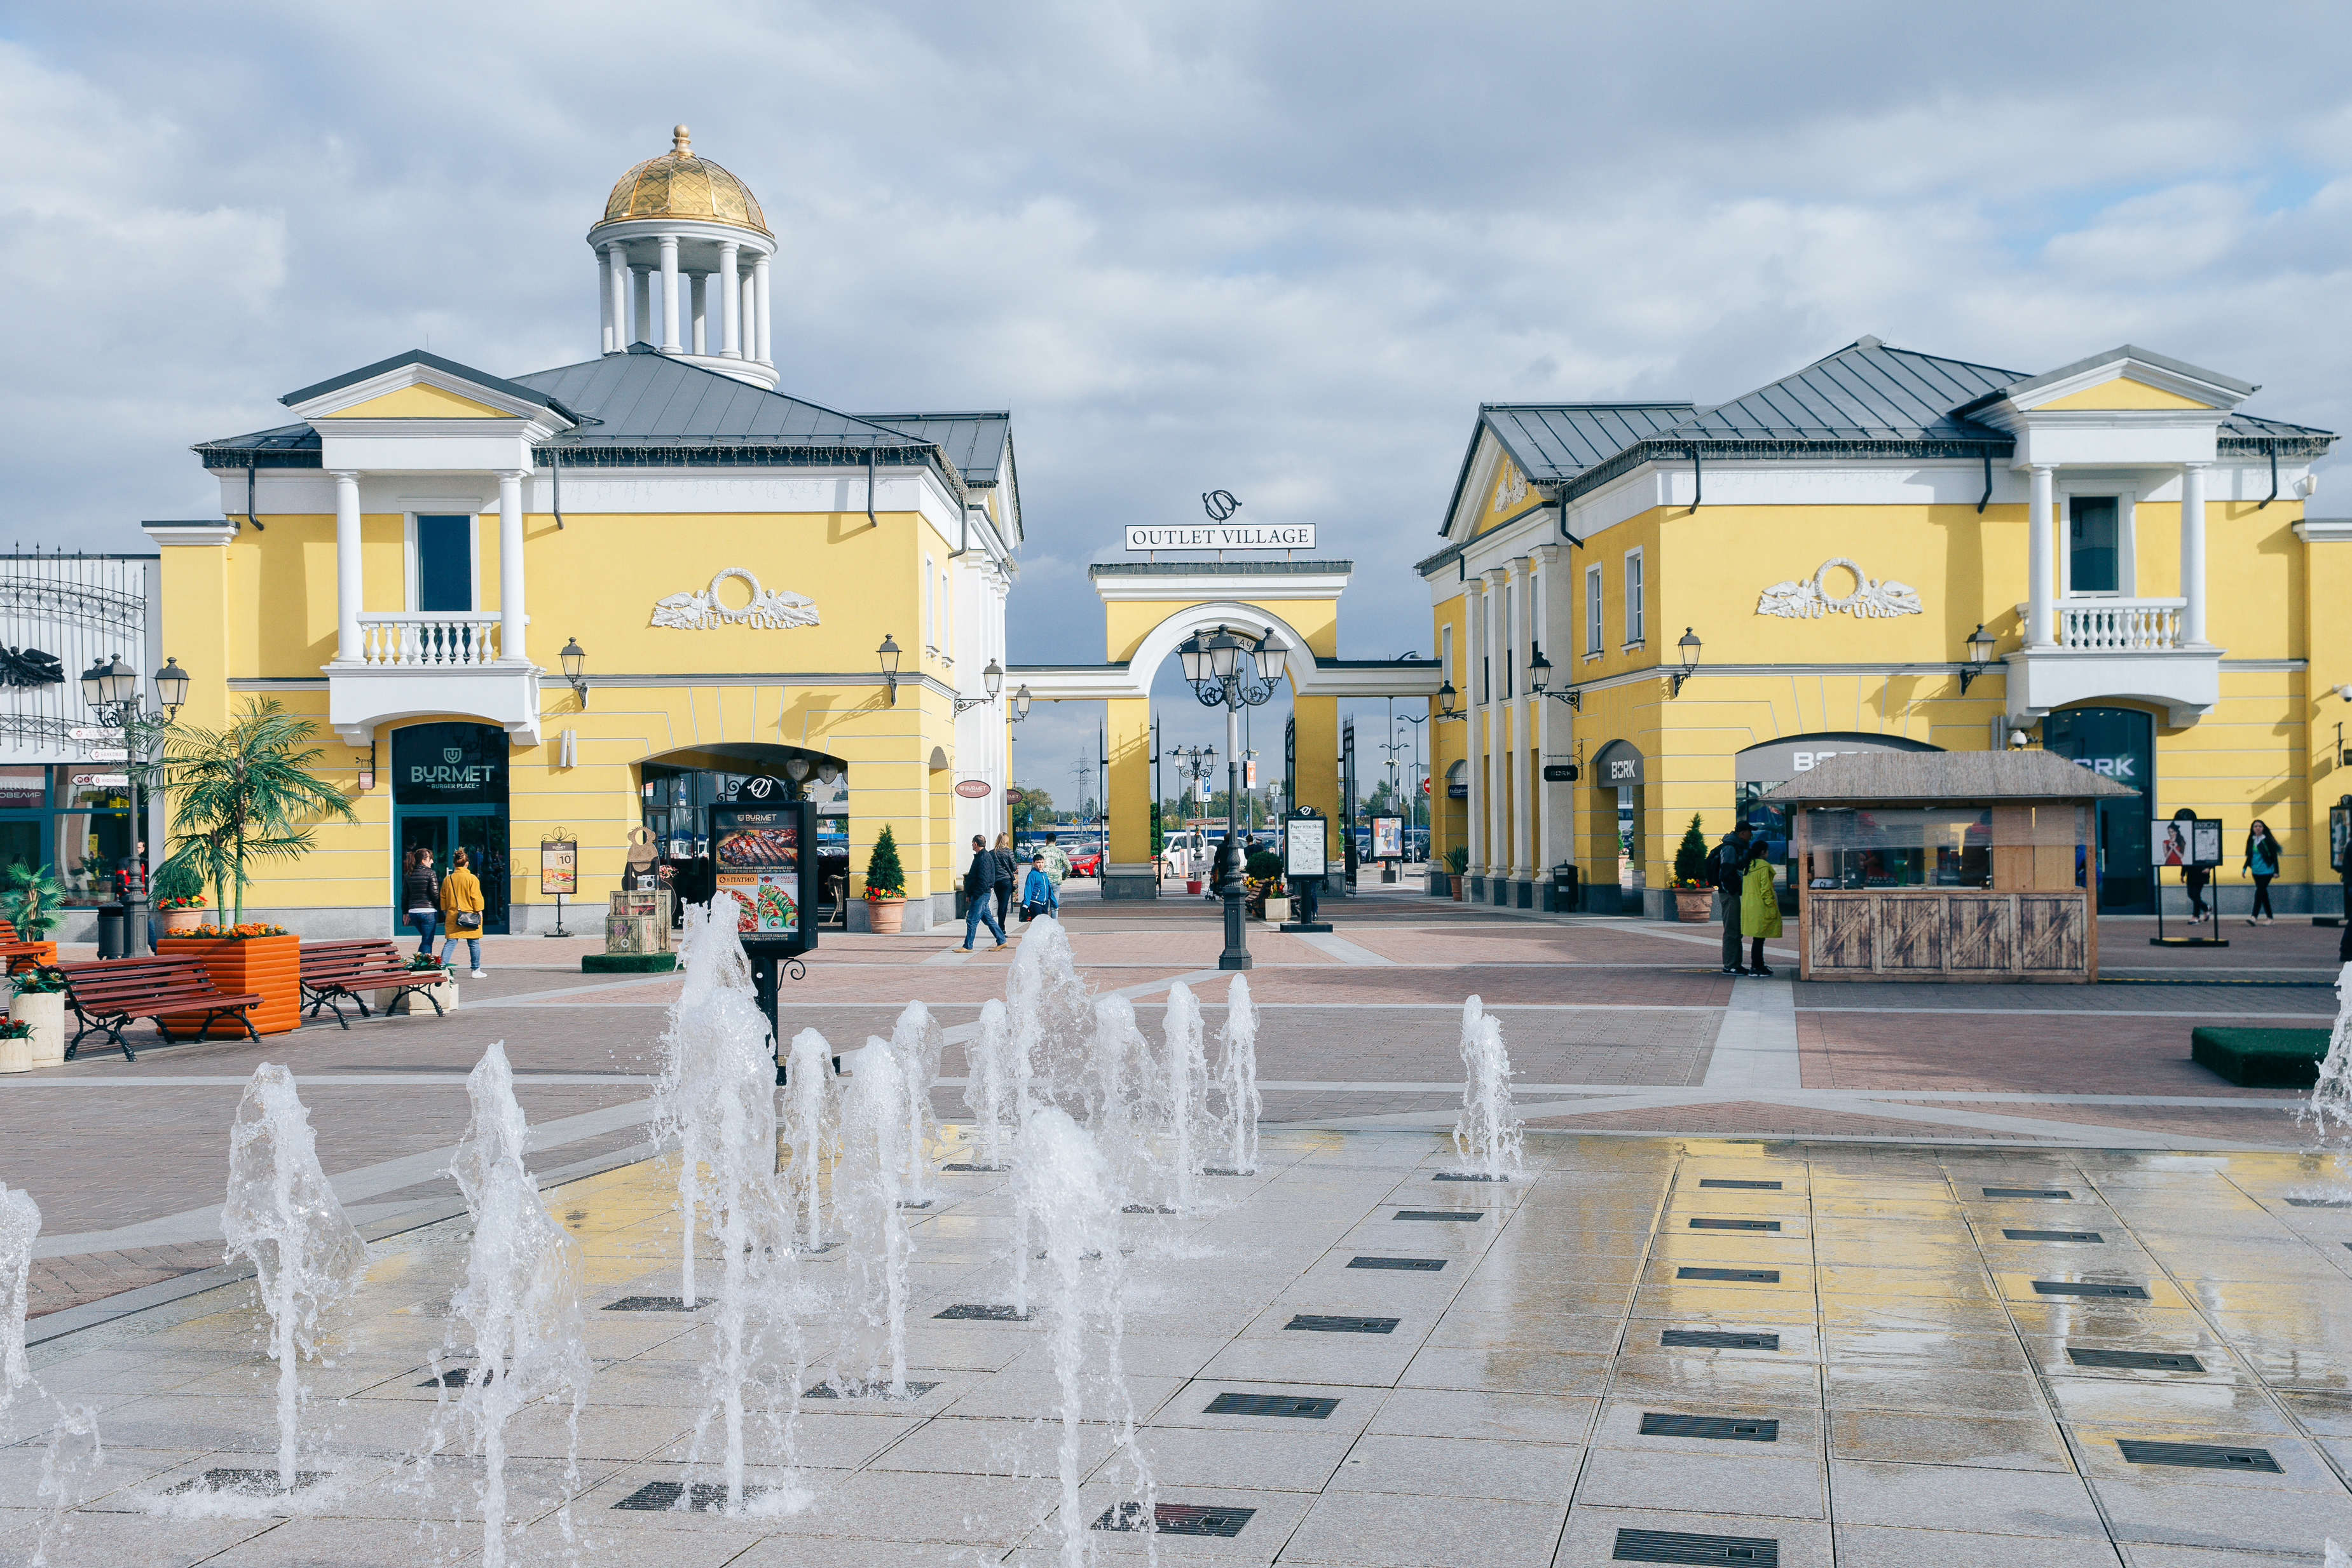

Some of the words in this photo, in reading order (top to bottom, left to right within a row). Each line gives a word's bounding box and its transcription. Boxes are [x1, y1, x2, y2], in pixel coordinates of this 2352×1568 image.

[1132, 529, 1215, 545] OUTLET
[1220, 529, 1309, 544] VILLAGE
[411, 765, 495, 782] BURMET
[1611, 760, 1636, 779] BORK
[559, 856, 571, 864] 10
